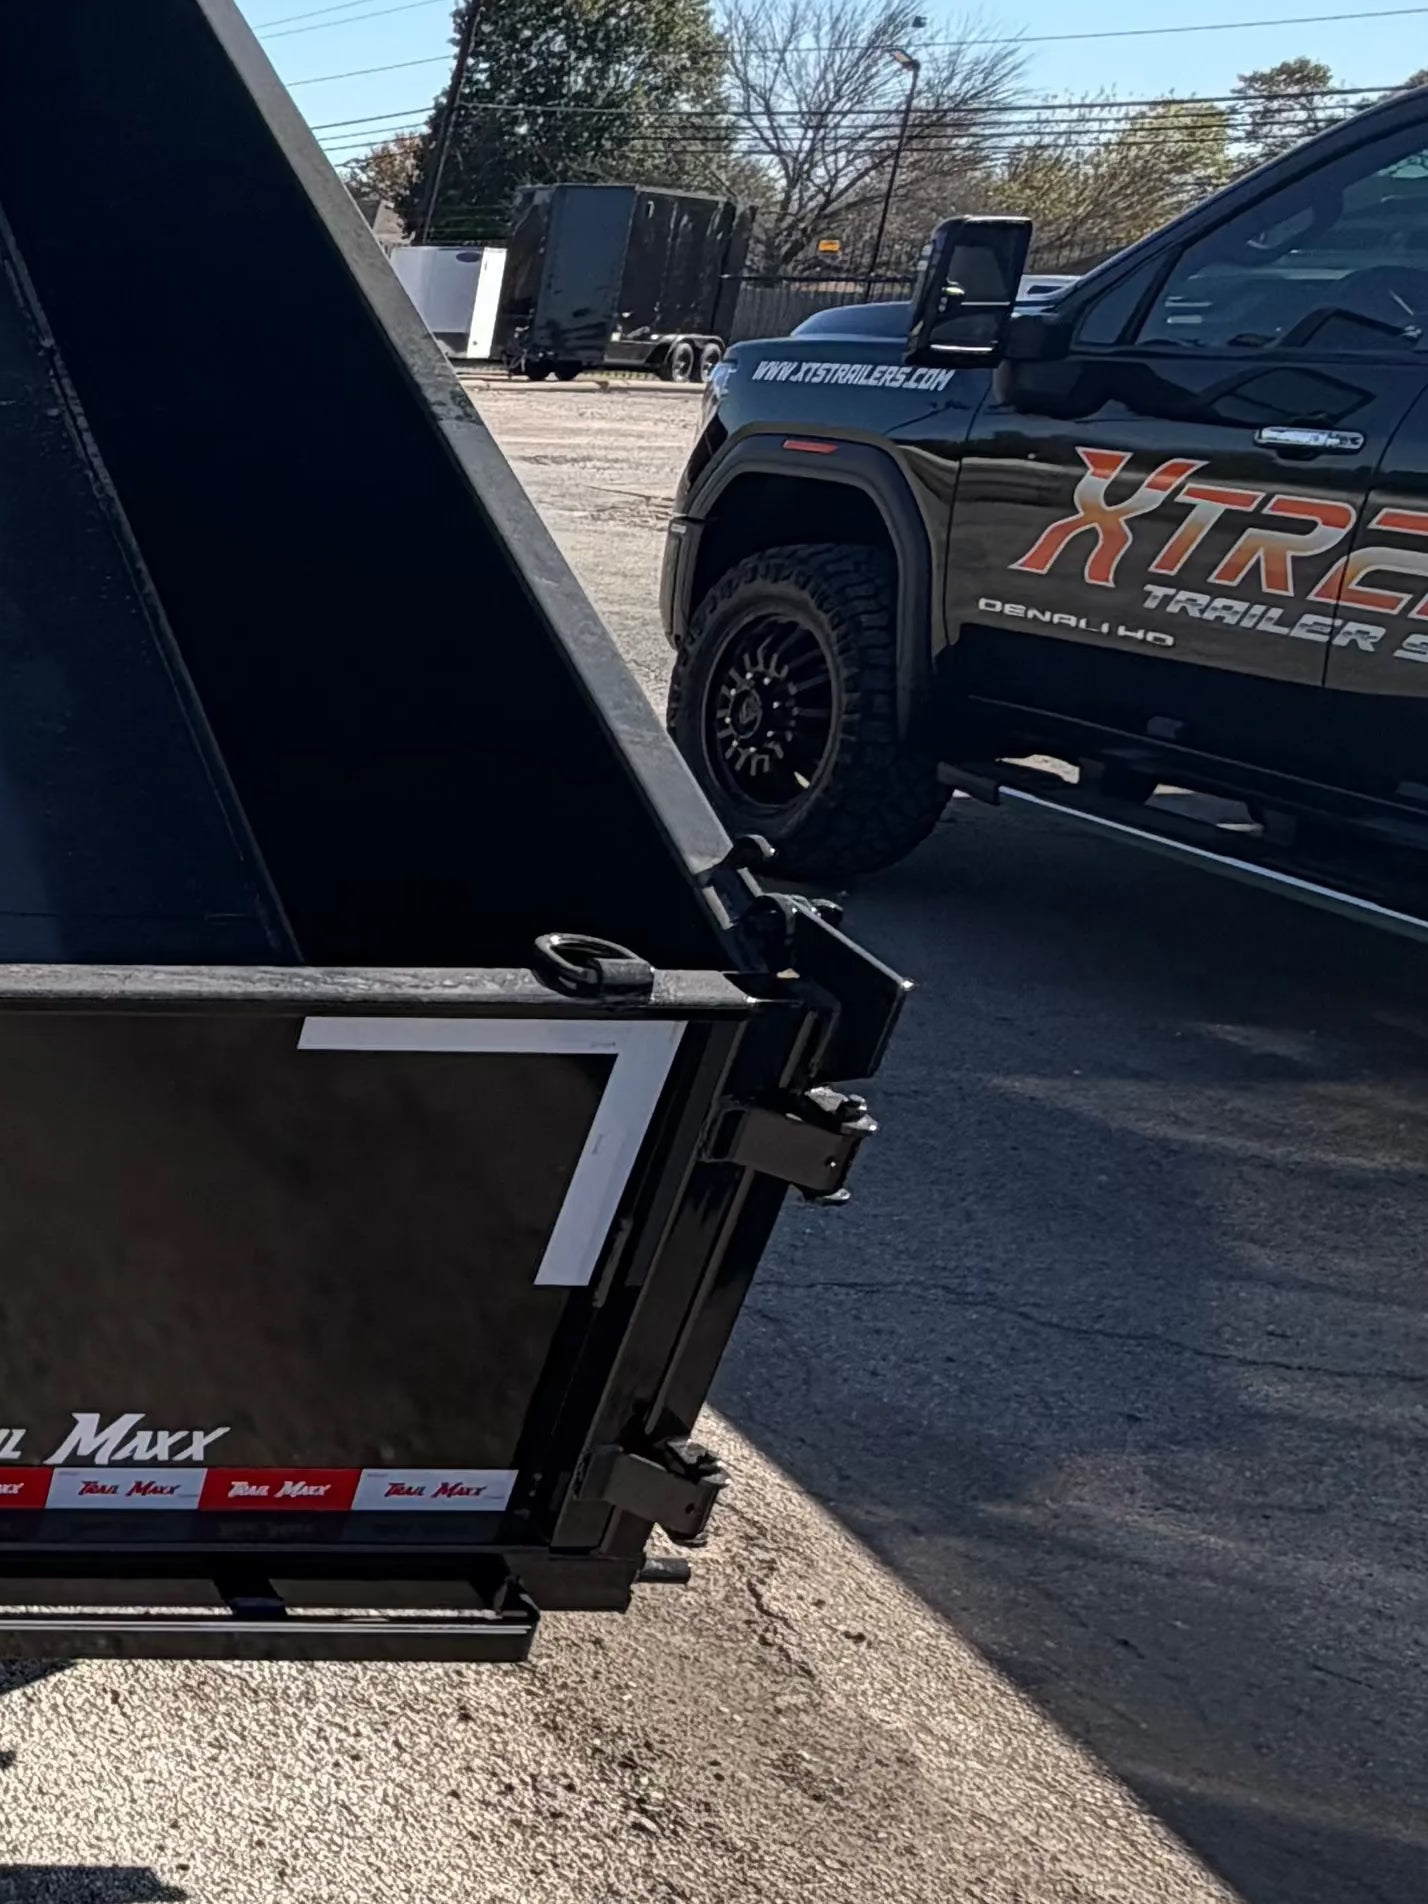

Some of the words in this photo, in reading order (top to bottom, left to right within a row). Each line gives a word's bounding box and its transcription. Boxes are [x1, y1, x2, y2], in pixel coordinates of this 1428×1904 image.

[752, 360, 956, 391] WWW.XTSTRAILERS.COM
[1007, 446, 1428, 621] XTRE
[978, 597, 1109, 635] DENALI
[1118, 625, 1175, 647] HD
[1143, 584, 1386, 652] TRAILER
